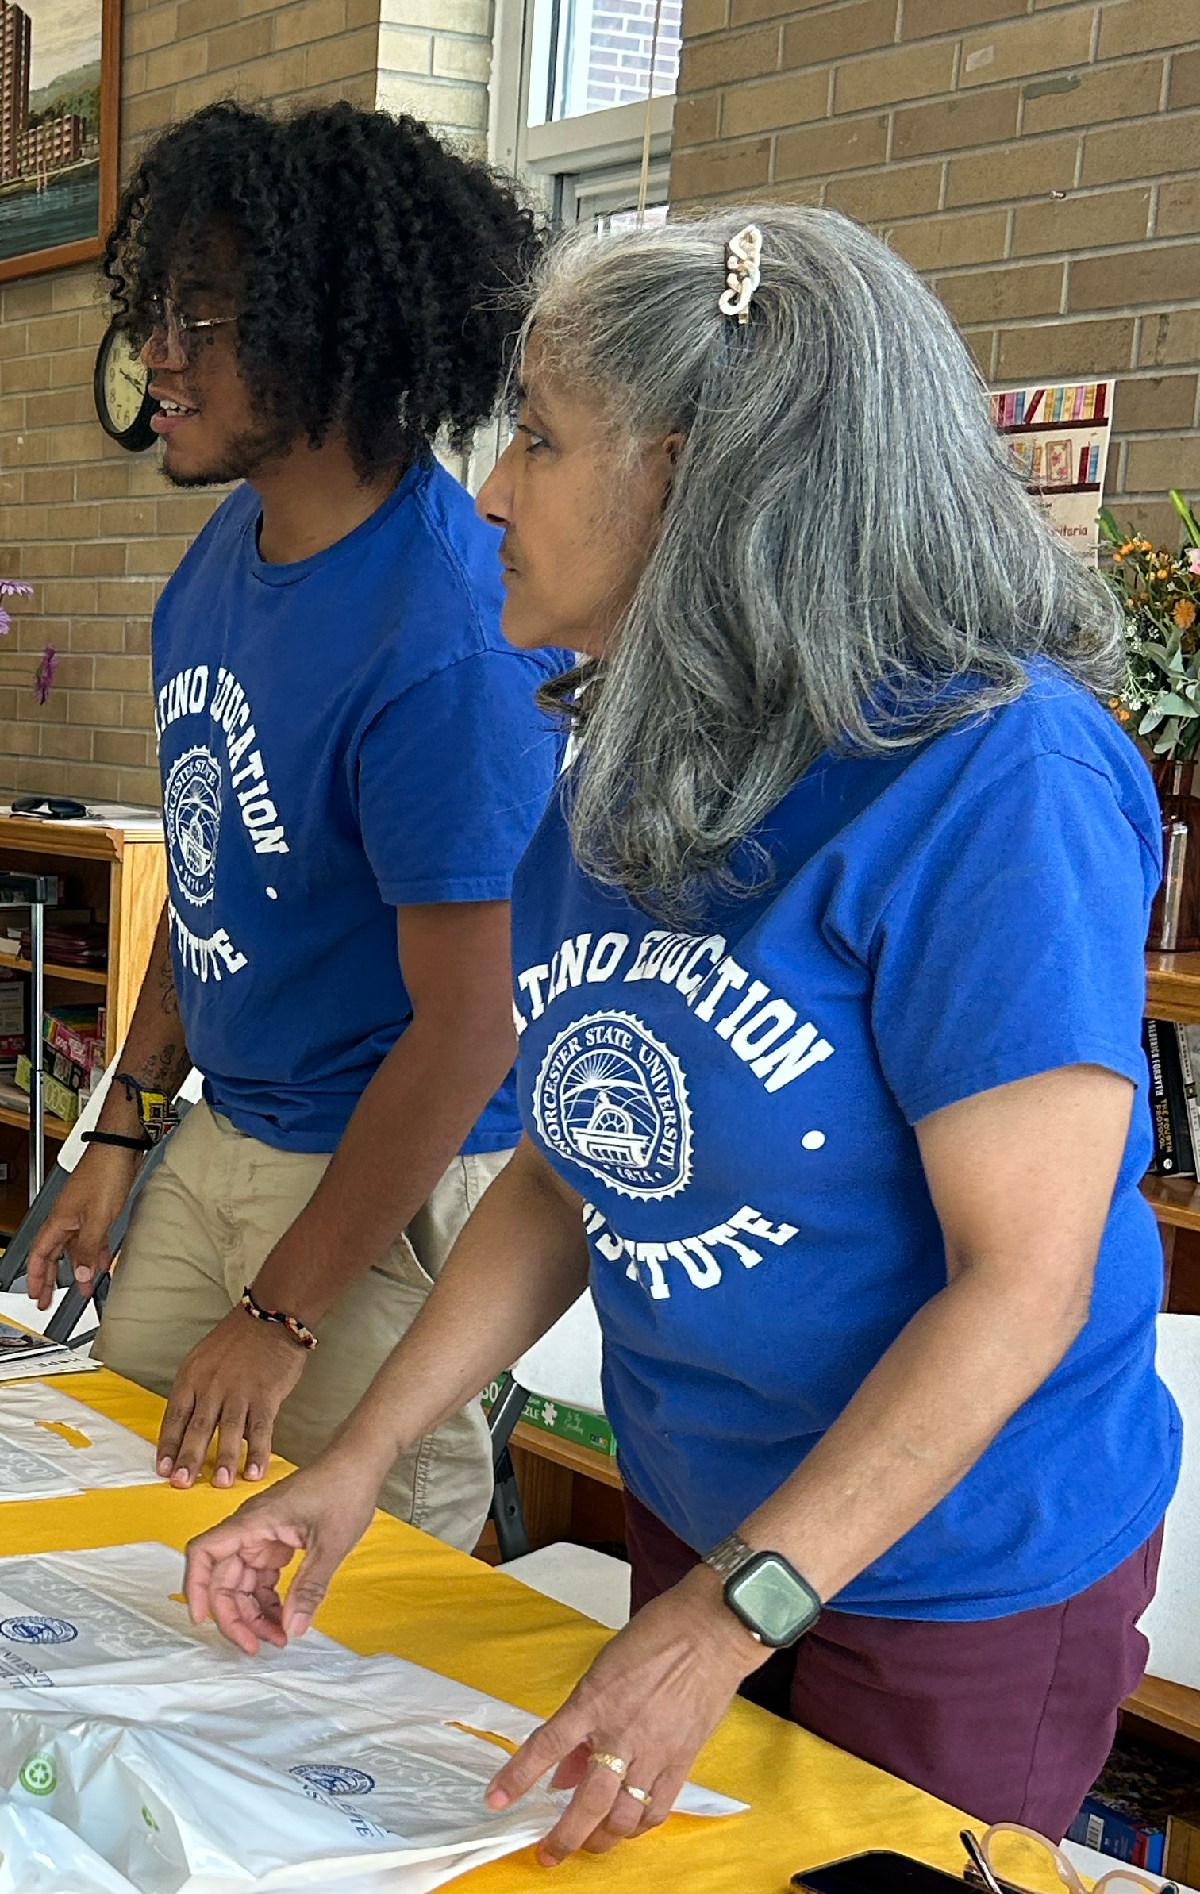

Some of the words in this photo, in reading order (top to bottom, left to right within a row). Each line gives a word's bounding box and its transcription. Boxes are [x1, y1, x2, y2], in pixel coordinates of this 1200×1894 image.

[512, 931, 630, 1035] TINO
[543, 1036, 584, 1156] WORCESTER
[585, 1025, 634, 1052] STATE
[638, 1043, 679, 1171] UNIVERSITY
